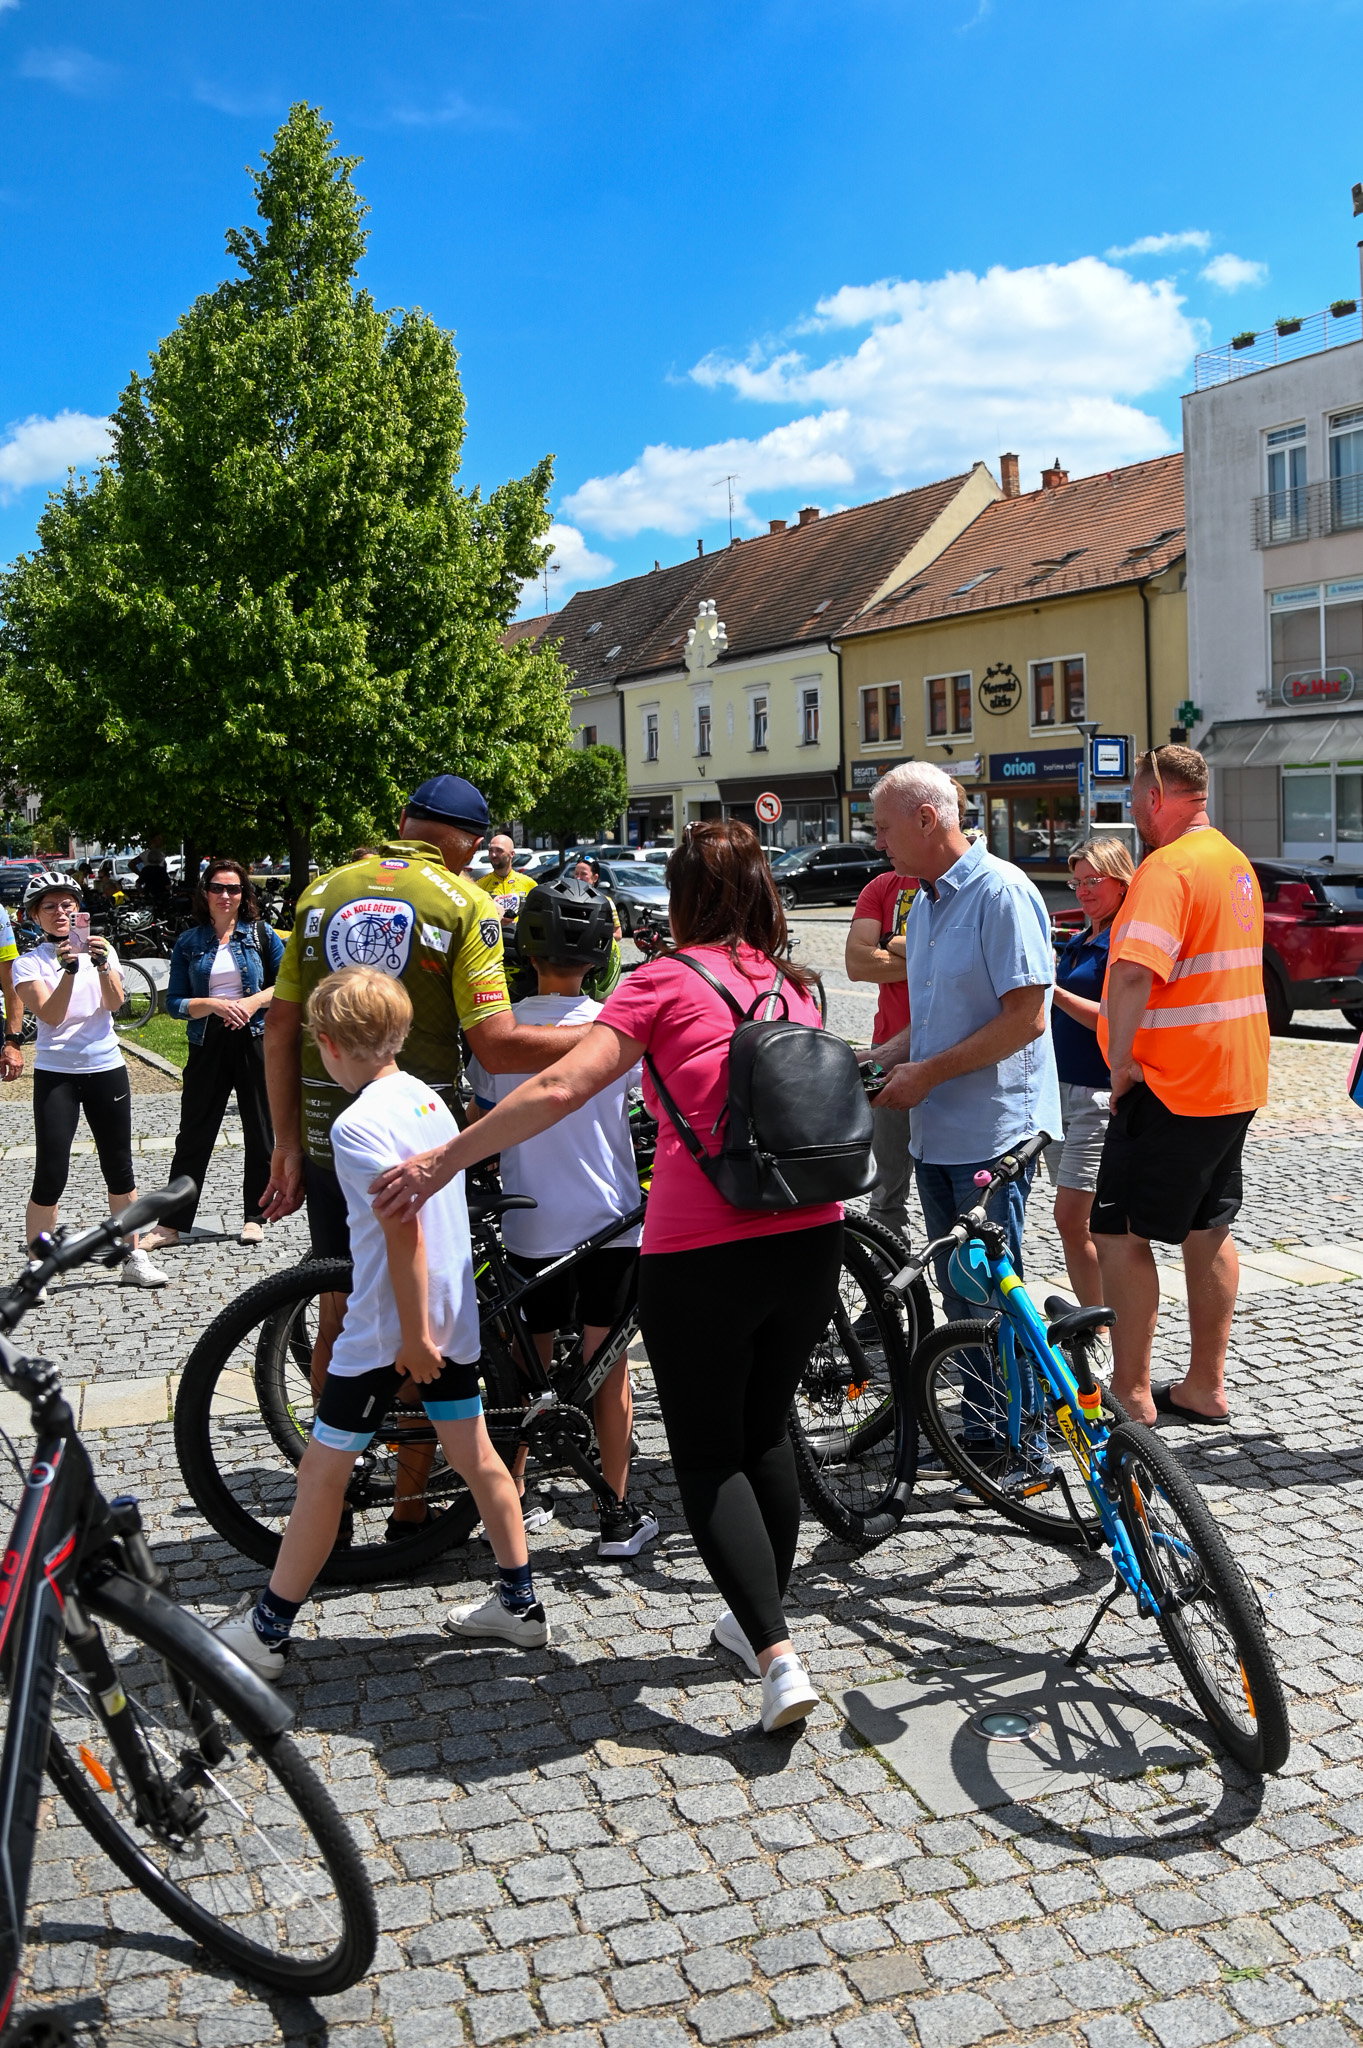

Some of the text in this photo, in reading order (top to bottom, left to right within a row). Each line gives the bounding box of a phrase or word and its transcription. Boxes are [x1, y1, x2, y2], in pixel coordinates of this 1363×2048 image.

[853, 767, 877, 777] REGATTA
[1003, 757, 1036, 776] orion
[427, 875, 468, 908] SULKO
[340, 903, 397, 921] NA KOLE DĚTEM
[330, 930, 341, 963] ON BIKE
[586, 1315, 640, 1401] ROCK
